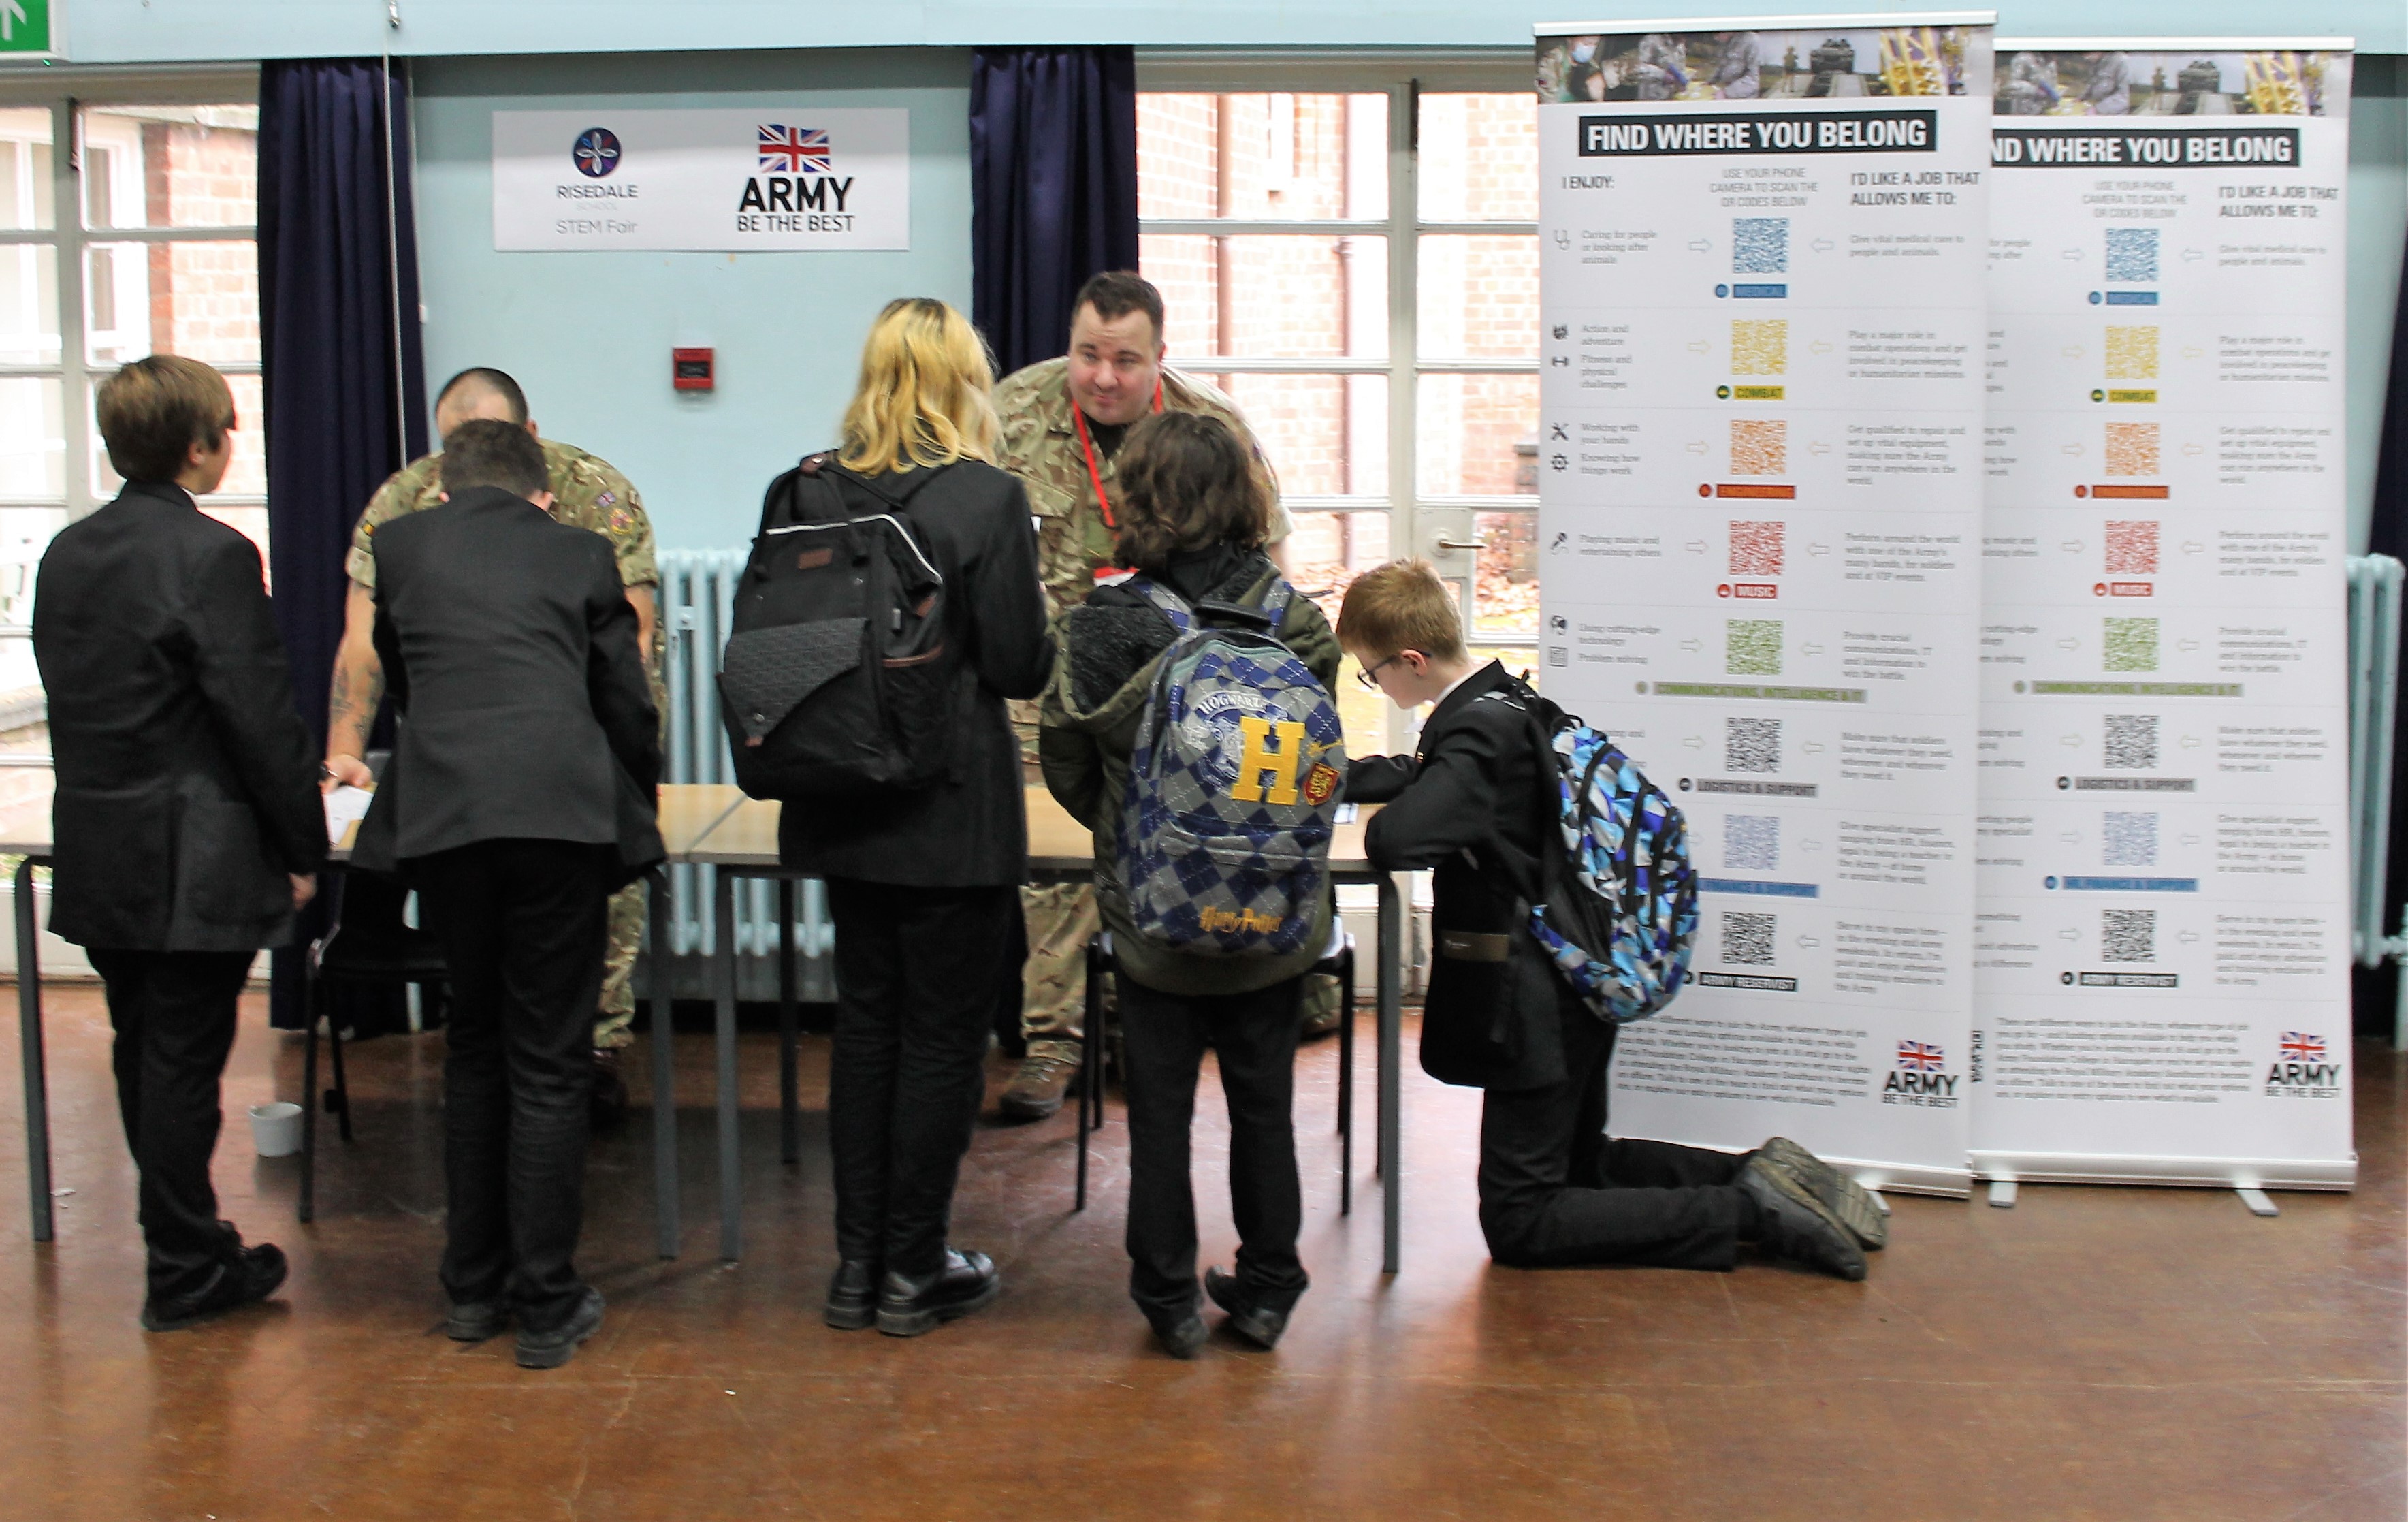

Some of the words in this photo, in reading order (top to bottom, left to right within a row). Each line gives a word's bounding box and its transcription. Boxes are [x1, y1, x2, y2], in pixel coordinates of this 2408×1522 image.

[1587, 124, 1648, 152] FIND
[1653, 122, 1751, 150] WHERE
[1759, 121, 1812, 148] YOU
[1818, 118, 1927, 148] BELONG
[1992, 139, 2023, 163] ND
[2026, 138, 2121, 163] WHERE
[2127, 138, 2179, 162] YOU
[2186, 137, 2292, 162] BELONG
[1722, 168, 1741, 179] USE
[1743, 168, 1769, 179] YOUR
[1773, 167, 1806, 178] PHONE
[1851, 172, 1867, 186] I'D
[1871, 172, 1899, 186] LIKE
[1903, 172, 1914, 185] A
[1917, 172, 1942, 185] JOB
[1945, 172, 1980, 185] THAT
[1570, 176, 1615, 189] ENJOY:
[1710, 182, 1754, 193] CAMERA
[1756, 182, 1768, 193] TO
[1770, 181, 1797, 193] SCAN
[1799, 181, 1818, 193] THE
[2095, 180, 2113, 191] USE
[2115, 180, 2139, 191] YOUR
[2142, 181, 2174, 191] PHONE
[557, 185, 639, 199] RISEDALE
[739, 177, 855, 212] ARMY
[1851, 193, 1908, 206] ALLOWS
[1910, 193, 1933, 206] ME
[1936, 192, 1957, 206] TO:
[2219, 186, 2236, 200] I'D
[2239, 186, 2266, 200] LIKE
[2270, 186, 2279, 199] A
[2281, 187, 2305, 200] JOB
[2309, 187, 2339, 200] THAT
[1736, 195, 1767, 208] CODES
[1770, 195, 1808, 207] BELOW
[2083, 194, 2125, 205] CAMERA
[2126, 195, 2138, 205] TO
[2141, 195, 2166, 205] SCAN
[2169, 195, 2187, 205] THE
[2110, 208, 2140, 219] CODES
[2143, 208, 2177, 219] BELOW
[2219, 205, 2275, 218] ALLOWS
[2277, 205, 2298, 218] ME
[557, 220, 603, 234] STEM
[607, 220, 638, 234] Fair
[737, 215, 760, 232] BE
[768, 215, 801, 232] THE
[808, 215, 855, 232] BEST
[1737, 586, 1776, 598] MUSIC
[2113, 584, 2151, 595] MUSIC
[1198, 693, 1265, 716] HOGWART
[1231, 716, 1306, 806] H
[1698, 780, 1752, 793] LOGISTICS
[1766, 783, 1816, 796] SUPPORT
[1199, 906, 1241, 934] Harry
[1240, 907, 1284, 934] Potter
[2268, 1063, 2341, 1087] ARMY
[1884, 1071, 1959, 1096] ARMY
[2265, 1087, 2281, 1098] BE
[2285, 1087, 2309, 1098] THE
[2311, 1087, 2341, 1098] BEST
[1882, 1093, 1897, 1104] BE
[1900, 1094, 1923, 1106] THE
[1928, 1096, 1959, 1108] BEST
